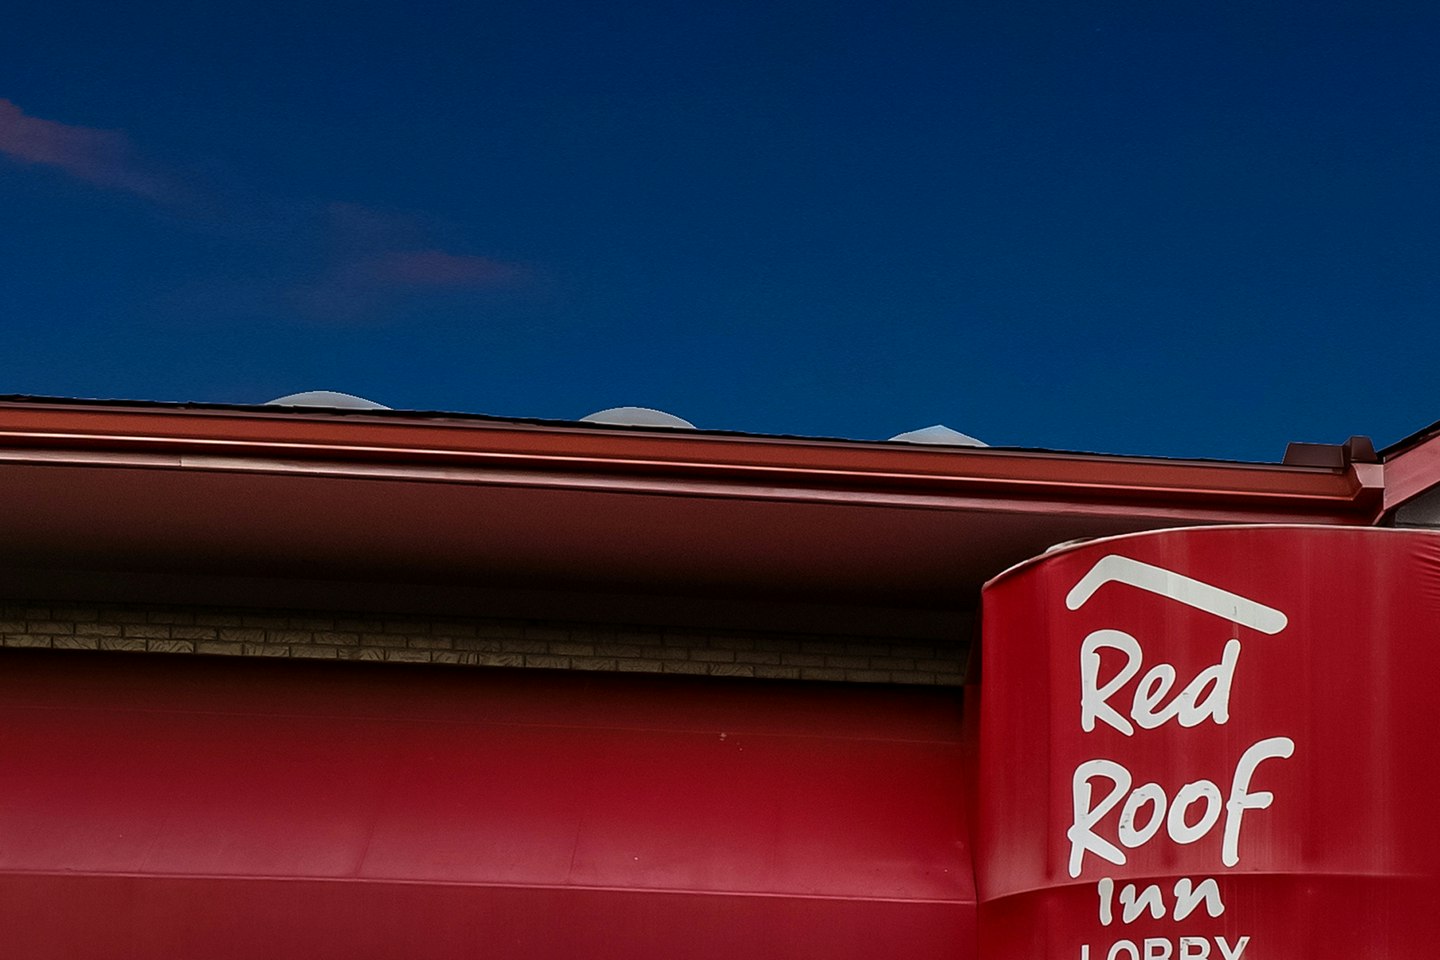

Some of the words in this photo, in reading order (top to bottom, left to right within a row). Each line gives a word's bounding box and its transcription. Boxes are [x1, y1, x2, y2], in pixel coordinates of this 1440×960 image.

[1080, 629, 1241, 737] Red
[1067, 736, 1295, 879] Roof
[1097, 876, 1225, 926] Inn
